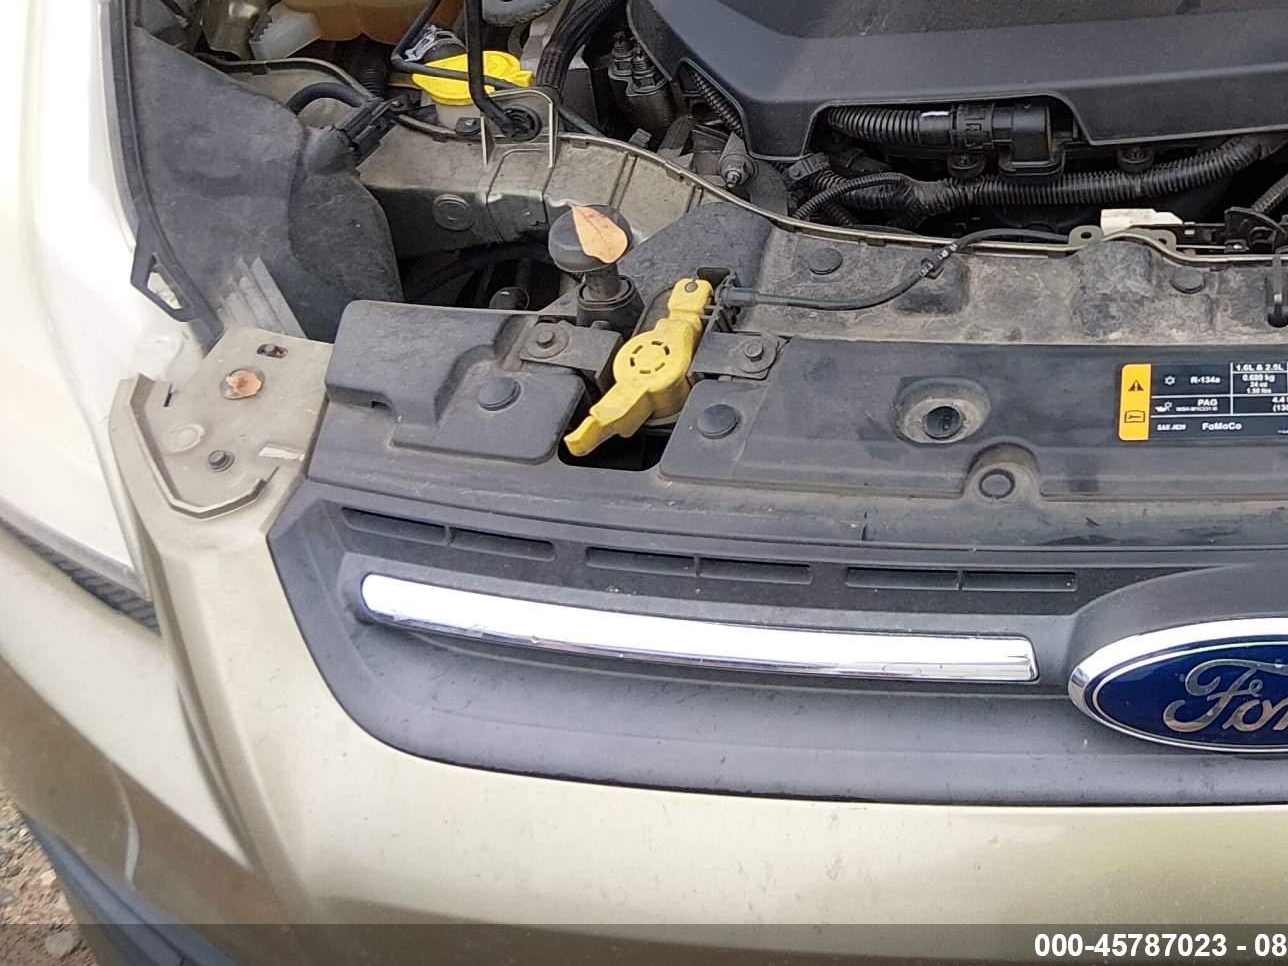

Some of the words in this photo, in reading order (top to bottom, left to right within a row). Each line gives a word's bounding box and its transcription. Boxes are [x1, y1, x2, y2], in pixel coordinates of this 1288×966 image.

[1236, 364, 1254, 372] 1.6L
[1190, 376, 1221, 384] R-134a
[1264, 374, 1275, 383] kg
[1197, 398, 1218, 406] PAG
[1202, 421, 1242, 430] FoMoCo
